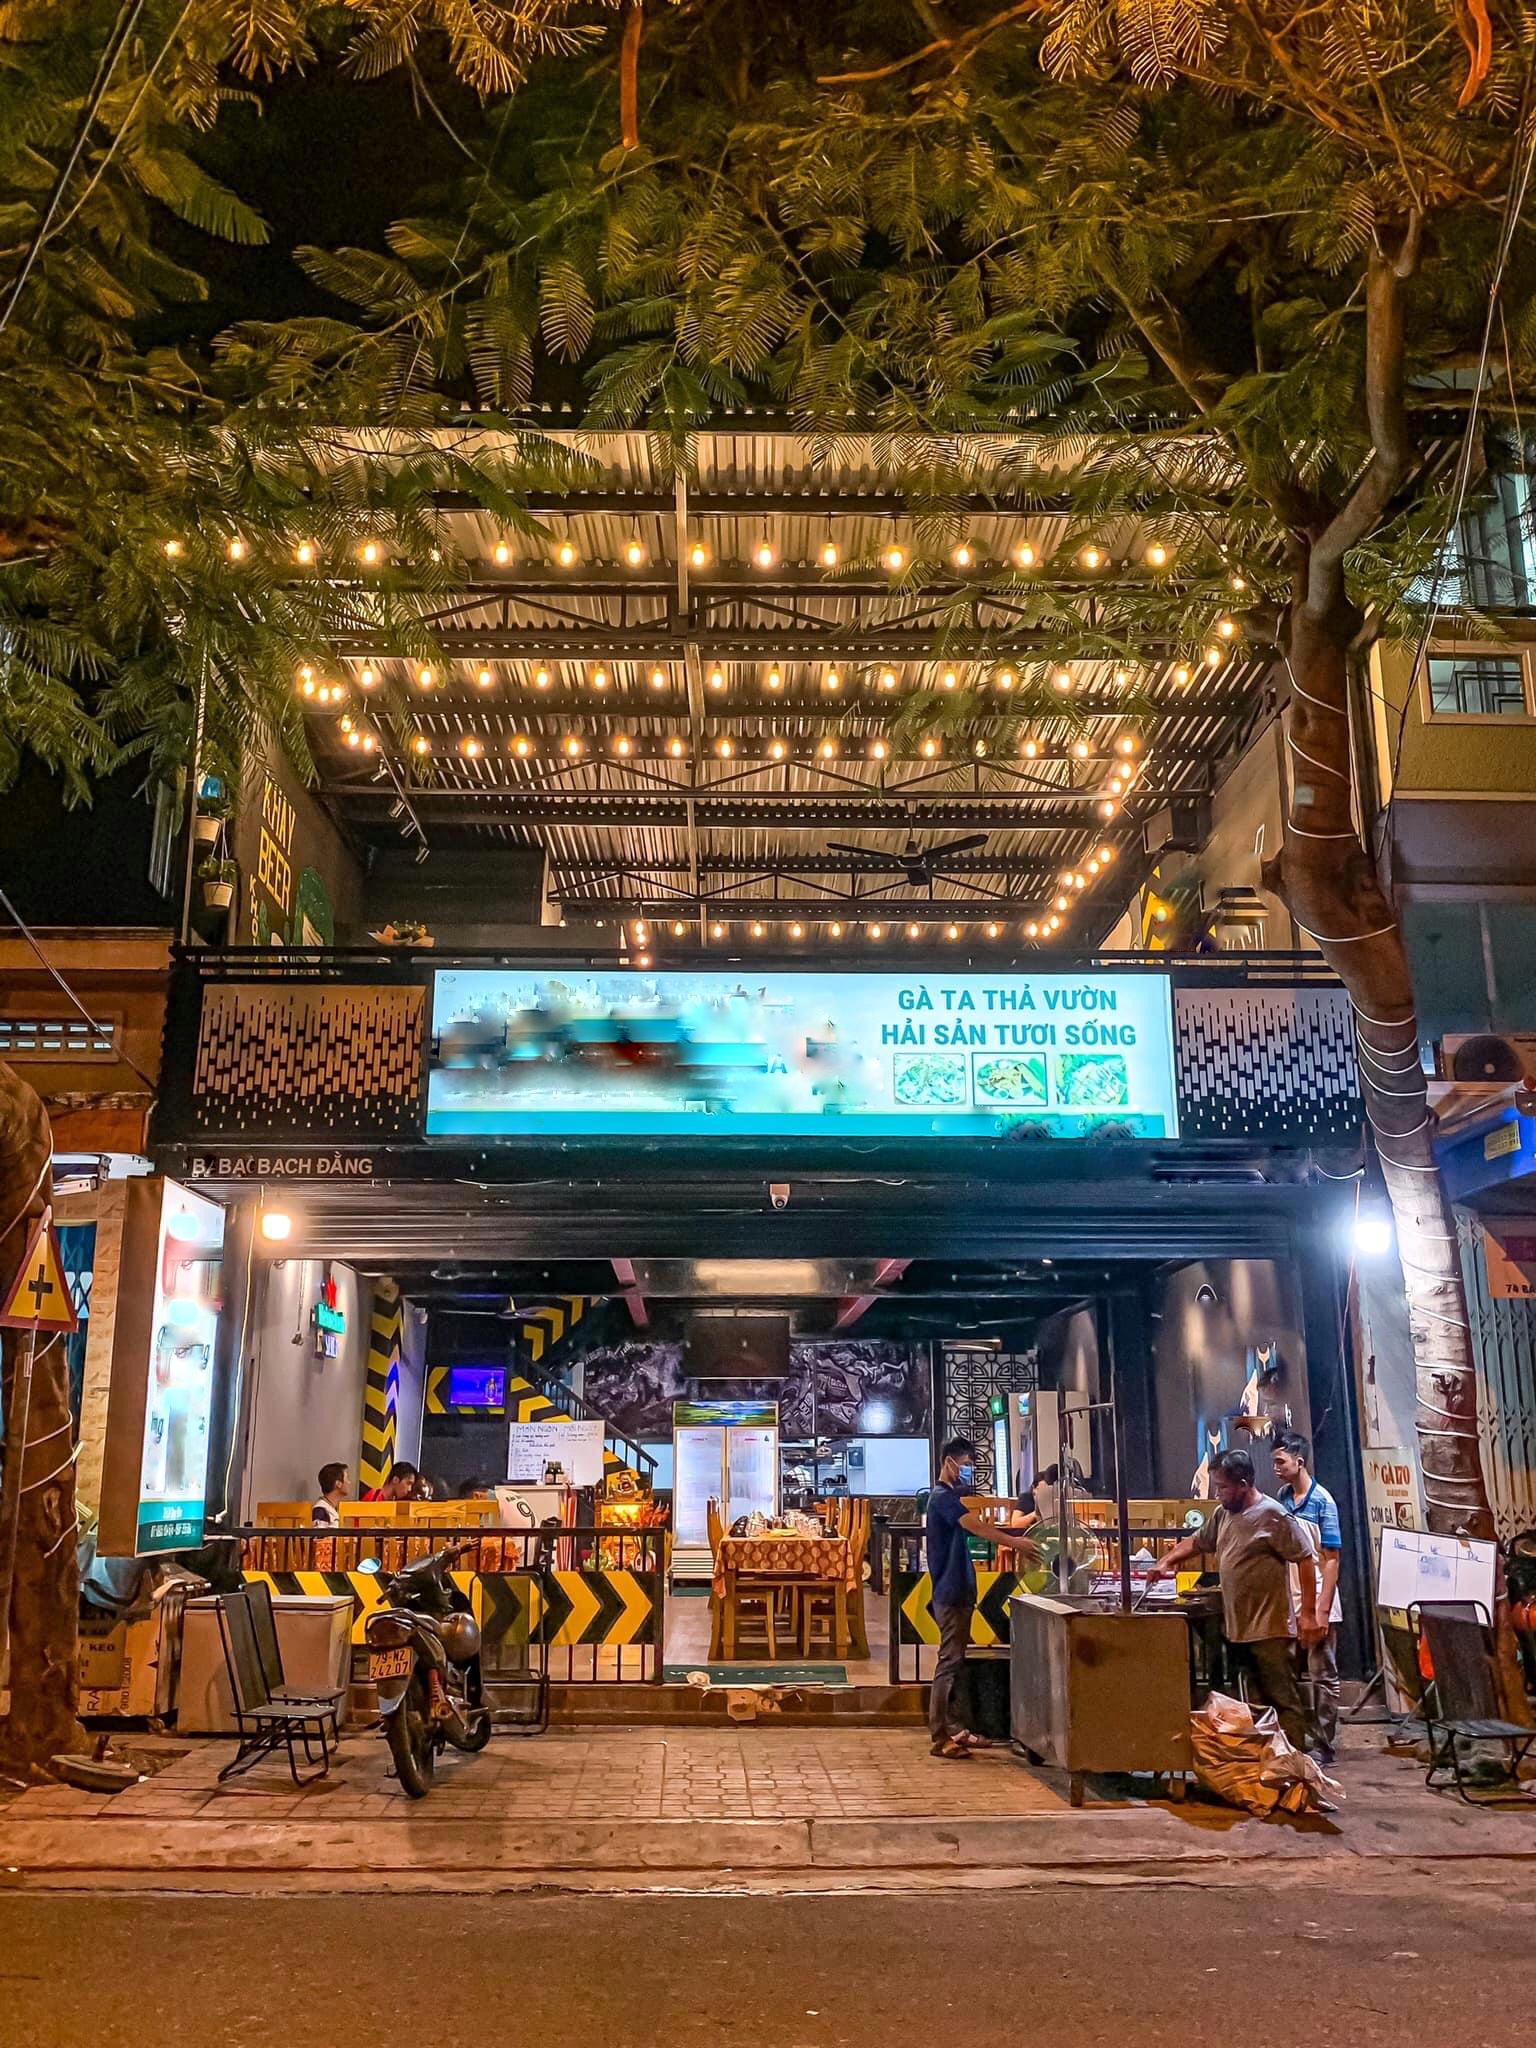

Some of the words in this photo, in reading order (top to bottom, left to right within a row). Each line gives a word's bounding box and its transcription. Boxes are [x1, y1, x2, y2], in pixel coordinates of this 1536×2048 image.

[258, 825, 292, 917] BEER
[898, 984, 934, 1011] GÀ
[940, 989, 976, 1011] TA
[982, 983, 1036, 1011] THẢ
[1043, 985, 1118, 1011] VƯỜN
[881, 1017, 926, 1046] HẢI
[934, 1018, 986, 1046] SẢN
[994, 1023, 1057, 1046] TƯƠI
[1065, 1018, 1137, 1046] SỐNG
[257, 1157, 311, 1177] BẠCH
[316, 1151, 373, 1175] ĐẰNG
